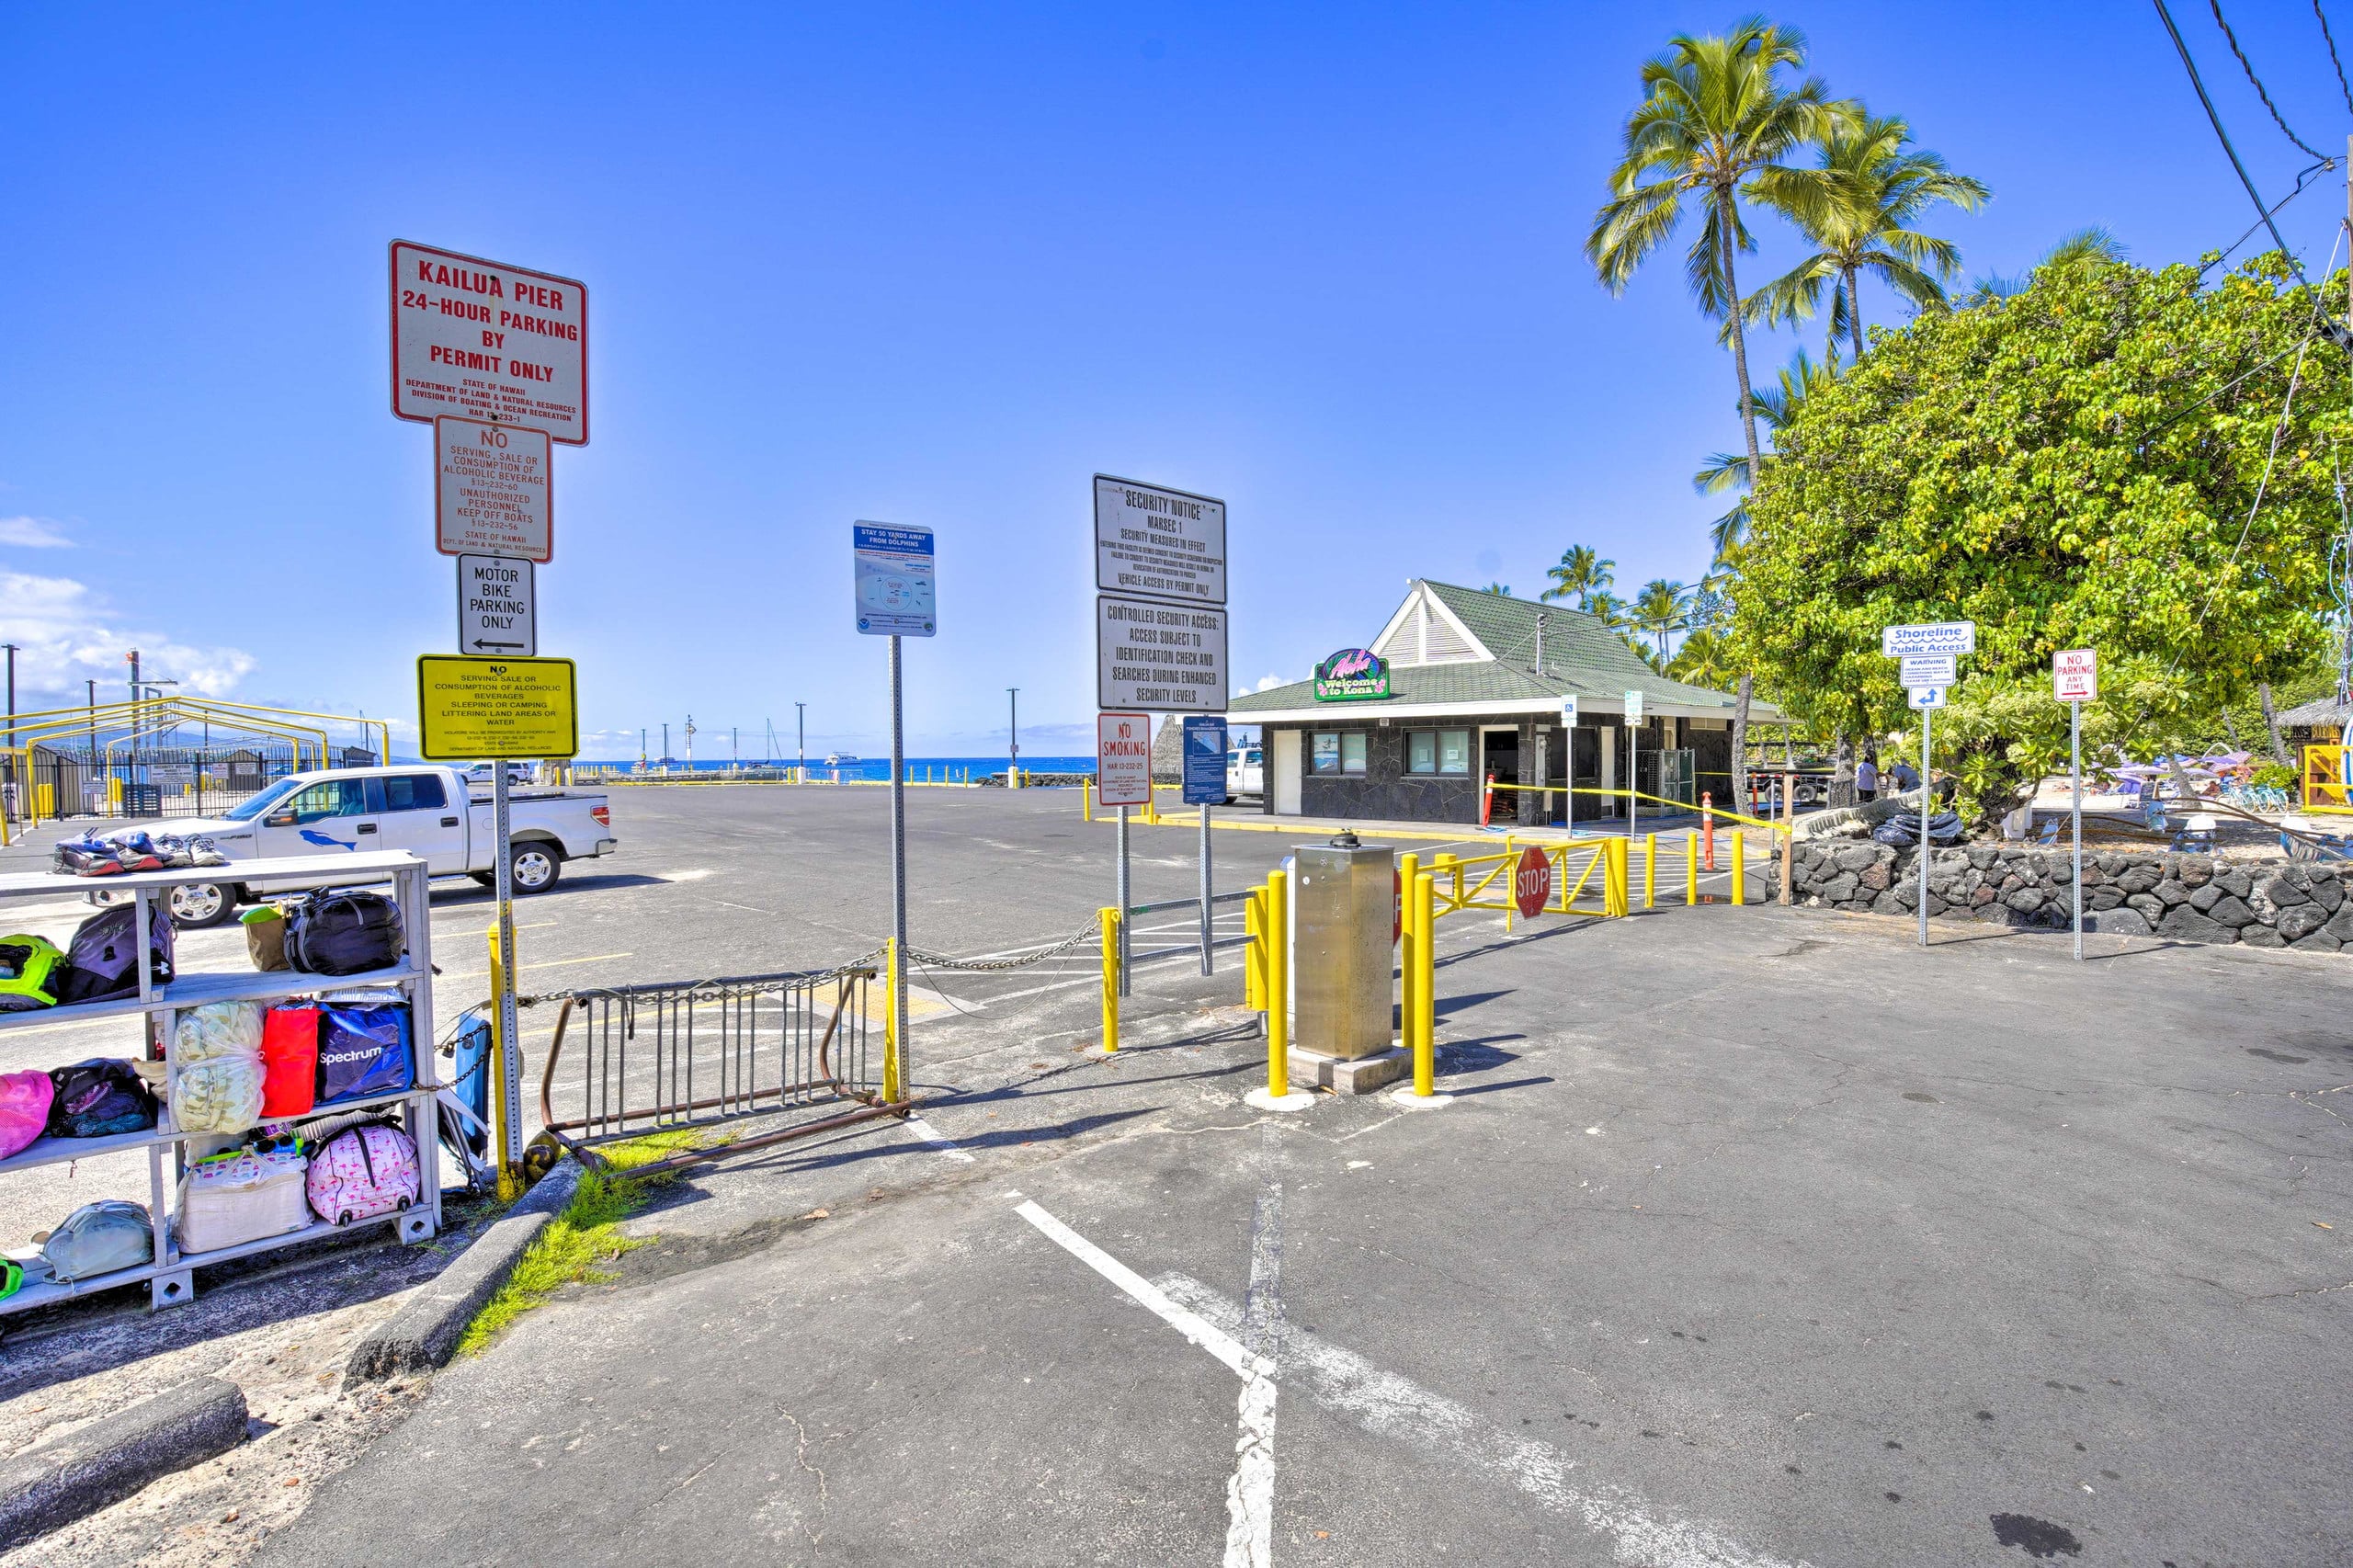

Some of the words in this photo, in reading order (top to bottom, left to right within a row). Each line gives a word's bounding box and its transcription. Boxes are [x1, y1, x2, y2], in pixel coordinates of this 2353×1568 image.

[419, 260, 503, 298] KAILUA
[515, 282, 563, 311] PIER
[404, 290, 491, 324] 24-HOUR
[501, 311, 577, 341] PARKING
[483, 331, 505, 348] BY
[431, 346, 501, 373] PERMIT
[510, 361, 553, 382] ONLY
[463, 379, 485, 390] STATE
[500, 385, 526, 395] HAWAII
[406, 379, 456, 394] DEPARTMENT
[460, 387, 468, 395] OF
[472, 390, 491, 400] LAND
[503, 395, 534, 406] NATURAL
[537, 402, 576, 414] RESOURCES
[412, 390, 445, 402] DIVISION
[460, 398, 492, 409] BOATING
[504, 404, 527, 415] OCEAN
[529, 409, 572, 422] RECREATION
[469, 409, 484, 417] HAR
[482, 430, 507, 448] NO
[454, 456, 519, 472] CONSUMPTION
[524, 466, 534, 474] OF
[500, 453, 521, 463] SALE
[527, 456, 538, 465] OR
[444, 465, 494, 479] ALCOHOLIC
[499, 472, 544, 485] BEVERAGE
[460, 488, 529, 504] UNAUTHORIZED
[469, 499, 521, 513] PERSONNEL
[1126, 490, 1168, 513] SECURITY
[1172, 500, 1200, 520] NOTICE
[458, 507, 481, 517] KEEP
[484, 510, 501, 519] OFF
[505, 512, 533, 523] BOATS
[1148, 516, 1176, 533] MARSEC
[1179, 522, 1182, 534] 1
[465, 531, 487, 540] STATE
[502, 535, 526, 543] HAWAII
[1121, 528, 1148, 542] SECURITY
[1150, 533, 1178, 548] MEASURES
[1180, 540, 1187, 550] IN
[1188, 540, 1206, 552] EFFECT
[515, 545, 545, 553] RESOURCES
[475, 567, 518, 582] MOTOR
[483, 584, 512, 597] BIKE
[1118, 573, 1141, 585] VEHICLE
[1143, 576, 1164, 589] ACCESS
[1166, 580, 1173, 590] BY
[1176, 581, 1194, 592] PERMIT
[1196, 584, 1209, 597] ONLY
[471, 599, 524, 614] PARKING
[482, 616, 513, 629] ONLY
[1108, 606, 1154, 623] CONTROLLED
[1157, 611, 1189, 627] SECURITY
[1130, 628, 1157, 642] ACCESS
[1160, 631, 1190, 646] SUBJECT
[1193, 634, 1200, 647] TO
[1895, 628, 1961, 638] Shoreline
[1116, 647, 1174, 663] IDENTIFICATION
[1176, 652, 1197, 665] CHECK
[1199, 653, 1213, 666] AND
[1891, 645, 1925, 653] Public
[1329, 649, 1370, 679] Aloha
[2067, 655, 2082, 665] NO
[1113, 666, 1150, 682] SEARCHES
[1153, 669, 1178, 683] DURING
[1182, 670, 1216, 685] ENHANCED
[2058, 665, 2092, 676] PARKING
[1325, 678, 1377, 687] Welcome
[1137, 687, 1170, 701] SECURITY
[1173, 689, 1196, 703] LEVELS
[1119, 724, 1131, 738] NO
[1104, 742, 1145, 756] SMOKING
[1518, 868, 1549, 898] STOP
[320, 1047, 381, 1065] Spectrum
